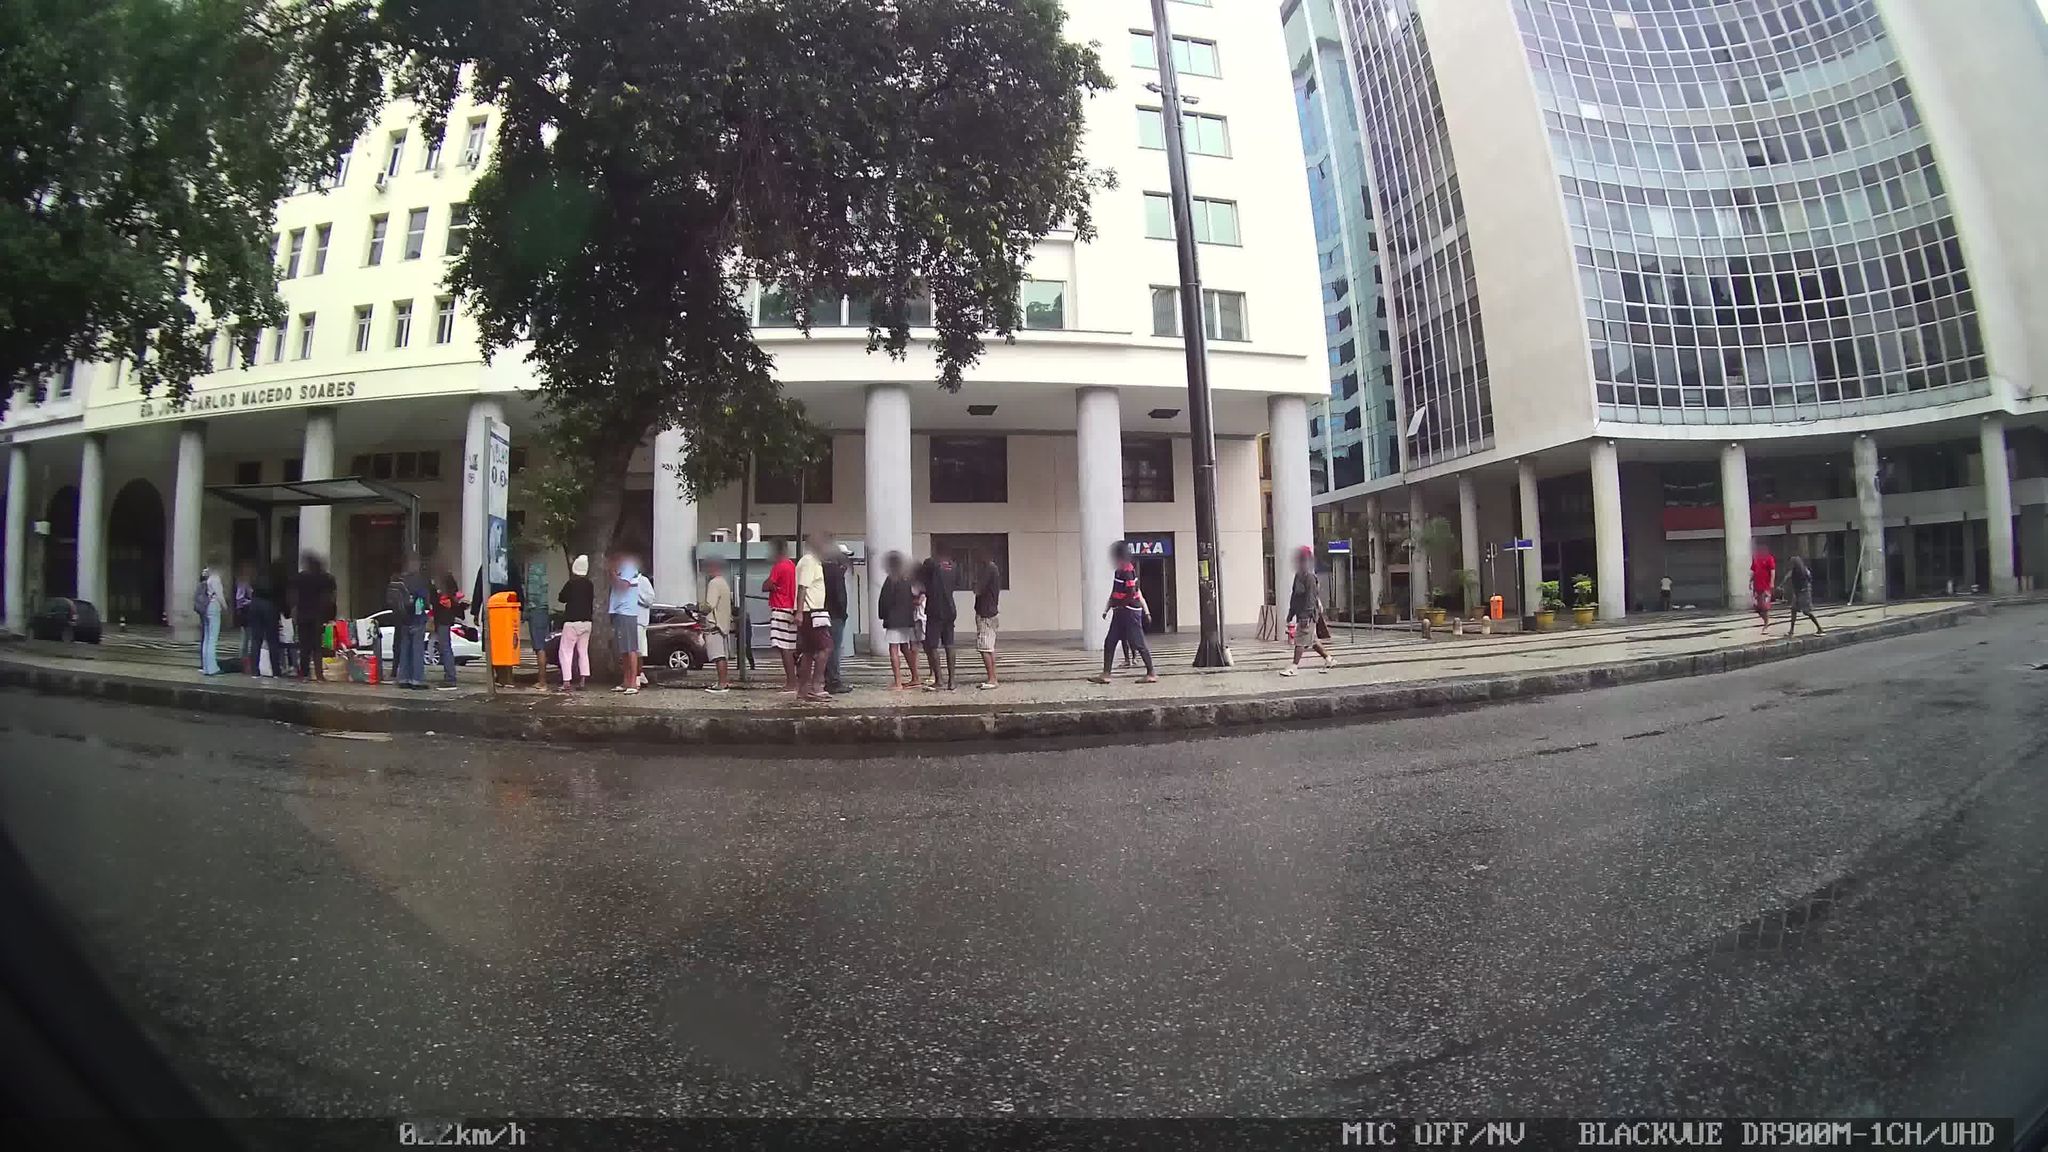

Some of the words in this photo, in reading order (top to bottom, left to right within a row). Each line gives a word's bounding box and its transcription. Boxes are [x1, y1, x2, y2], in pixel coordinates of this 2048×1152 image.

[191, 392, 236, 412] CARLOS
[242, 386, 292, 406] MACEDO
[299, 381, 356, 400] SOARES
[1127, 541, 1164, 554] AIXA
